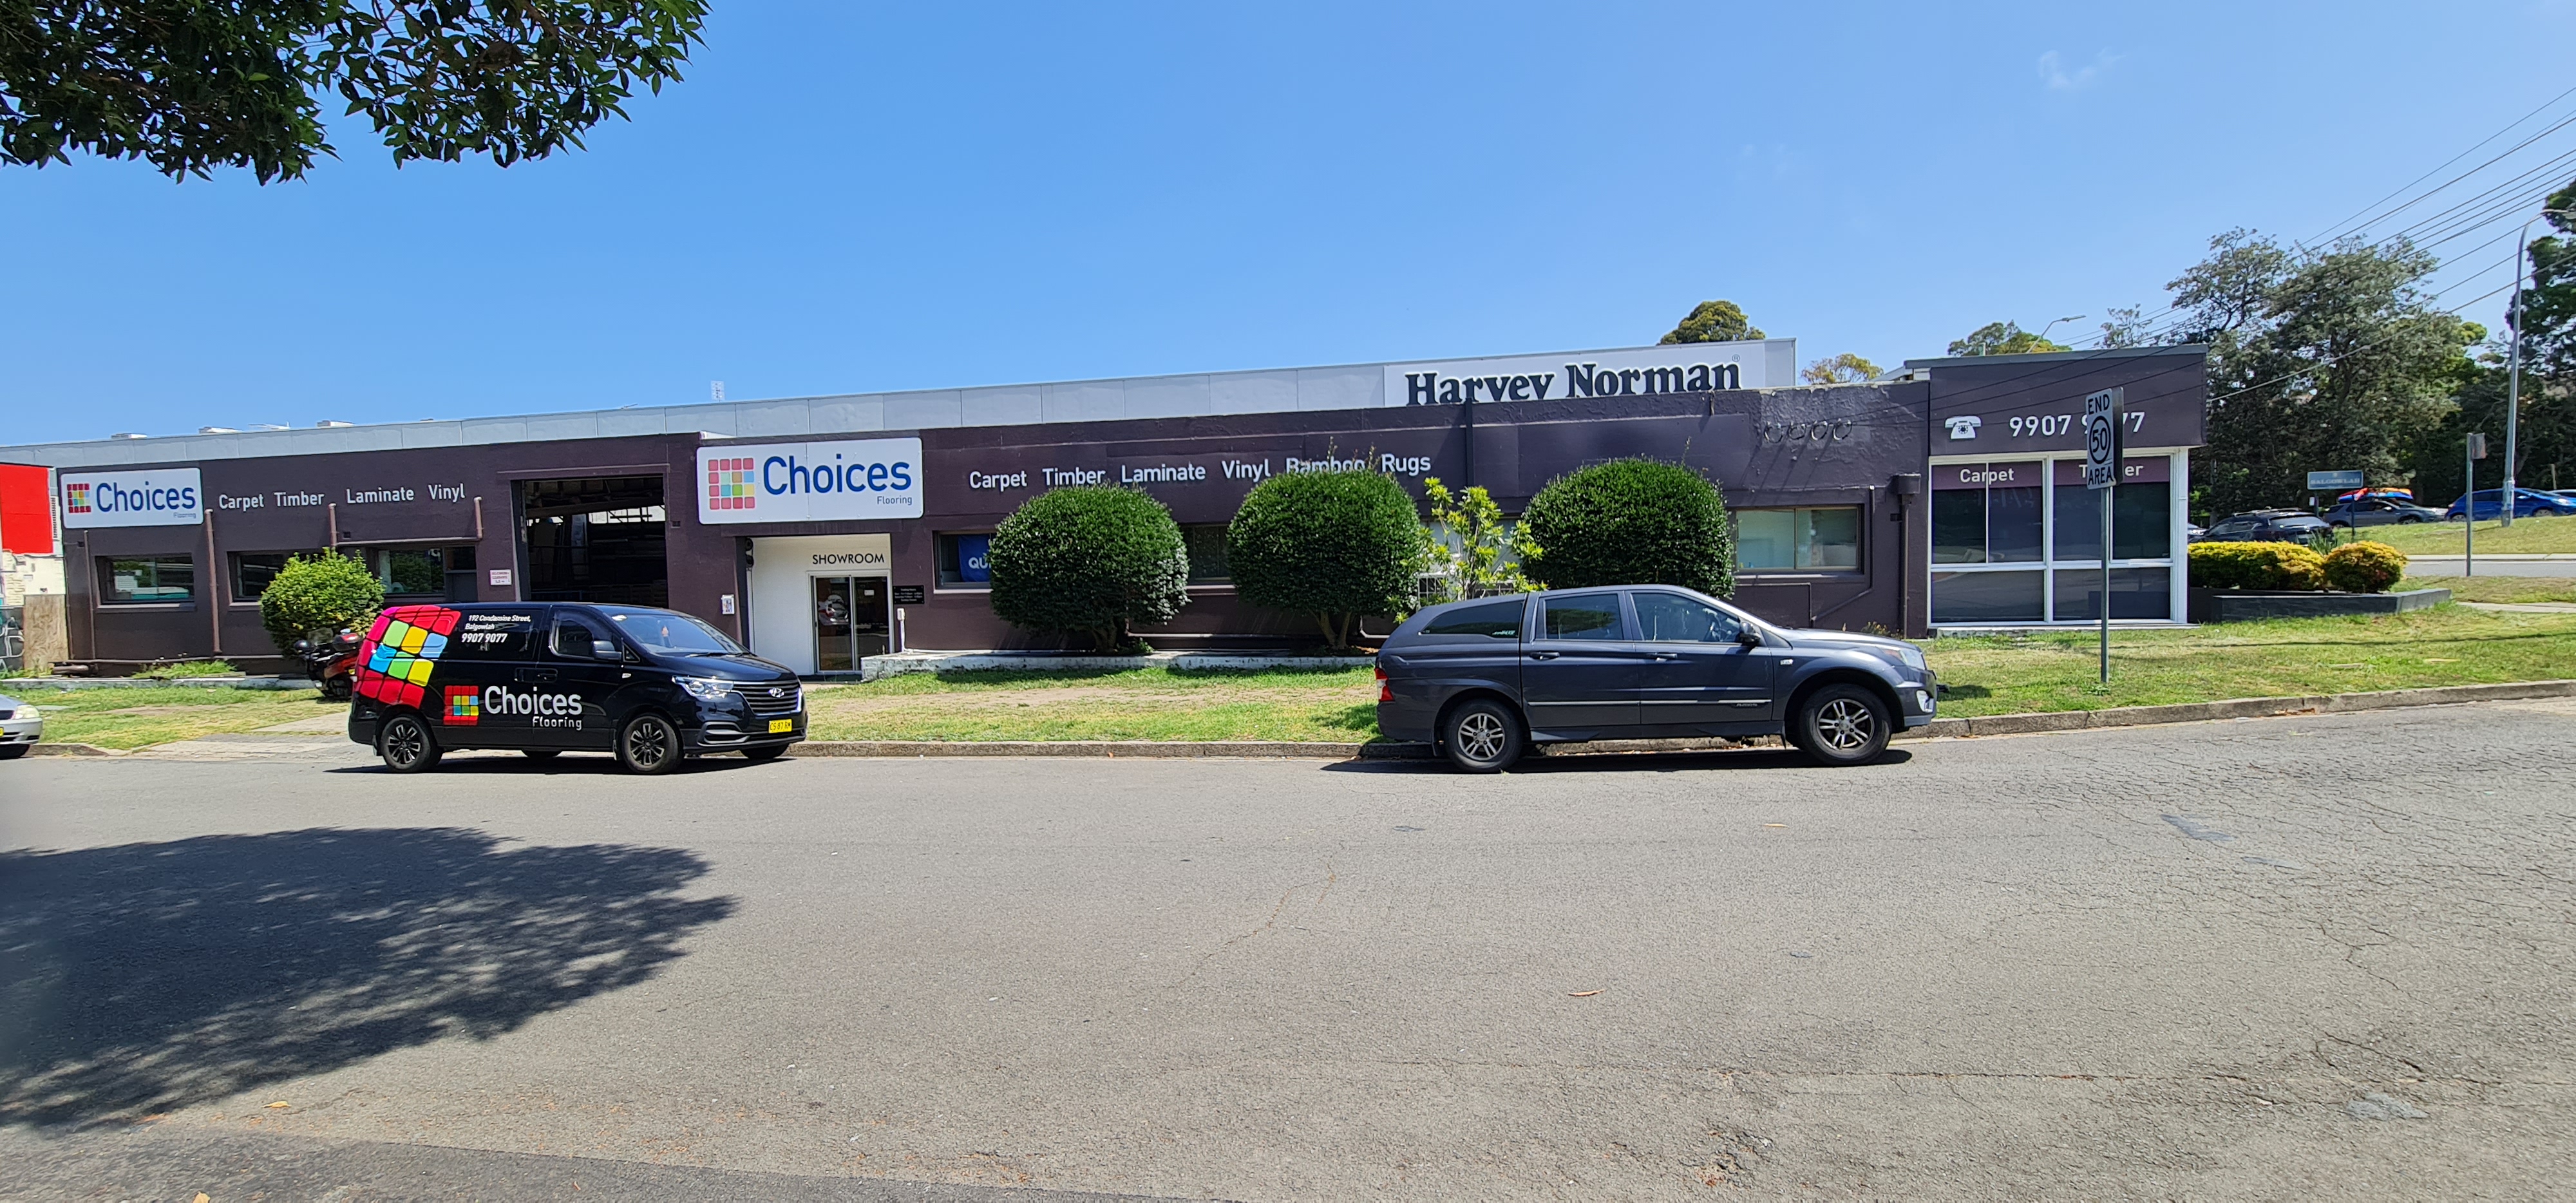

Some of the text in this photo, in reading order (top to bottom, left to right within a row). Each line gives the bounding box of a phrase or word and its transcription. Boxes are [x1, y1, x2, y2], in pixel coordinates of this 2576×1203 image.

[1405, 363, 1742, 406] Harvey Norman
[2088, 394, 2110, 415] END
[2009, 414, 2072, 437] 9907
[2092, 428, 2108, 453] 50
[763, 453, 912, 495] Choices
[969, 470, 1027, 491] Carpet
[1042, 467, 1106, 486] Timber
[1121, 462, 1206, 483] Laminate
[1222, 459, 1271, 482] Vinyl
[1381, 453, 1432, 477] Rugs
[1960, 468, 2014, 485] Carpet
[2088, 466, 2114, 486] AREA
[97, 480, 196, 513] Choices
[218, 483, 466, 512] Carpet Timber Laminate Vinyl
[876, 495, 913, 506] Flooring
[812, 553, 885, 565] SHOWROOM
[968, 556, 992, 569] QU
[461, 632, 508, 643] 9907 9077
[464, 623, 495, 631] Balgowlah
[484, 685, 583, 715] Choices
[532, 716, 582, 730] Flooring
